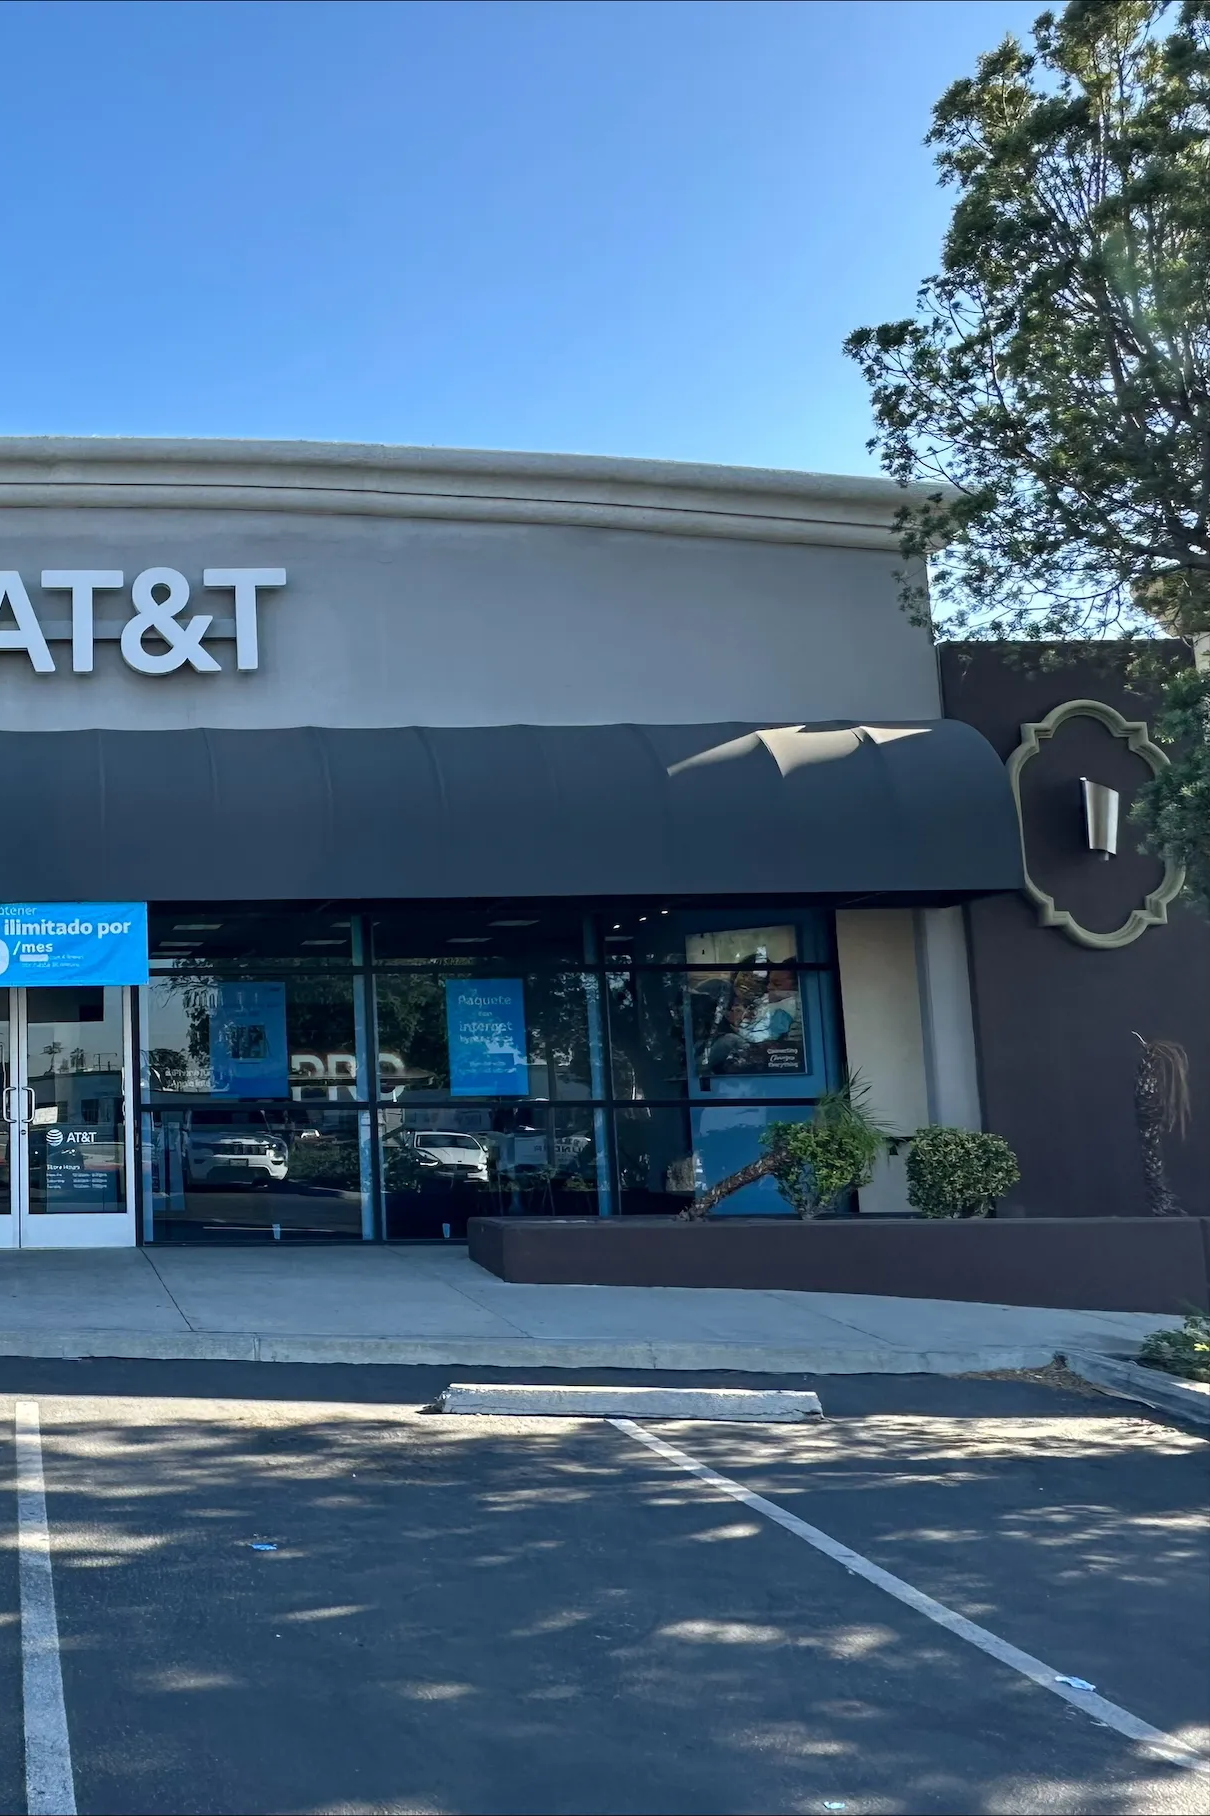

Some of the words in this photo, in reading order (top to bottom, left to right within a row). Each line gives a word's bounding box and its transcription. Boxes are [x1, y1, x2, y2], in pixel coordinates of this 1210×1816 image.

[4, 918, 93, 936] ilimitado
[97, 921, 131, 939] por
[458, 995, 511, 1008] Paquete
[66, 1131, 97, 1143] AT&T
